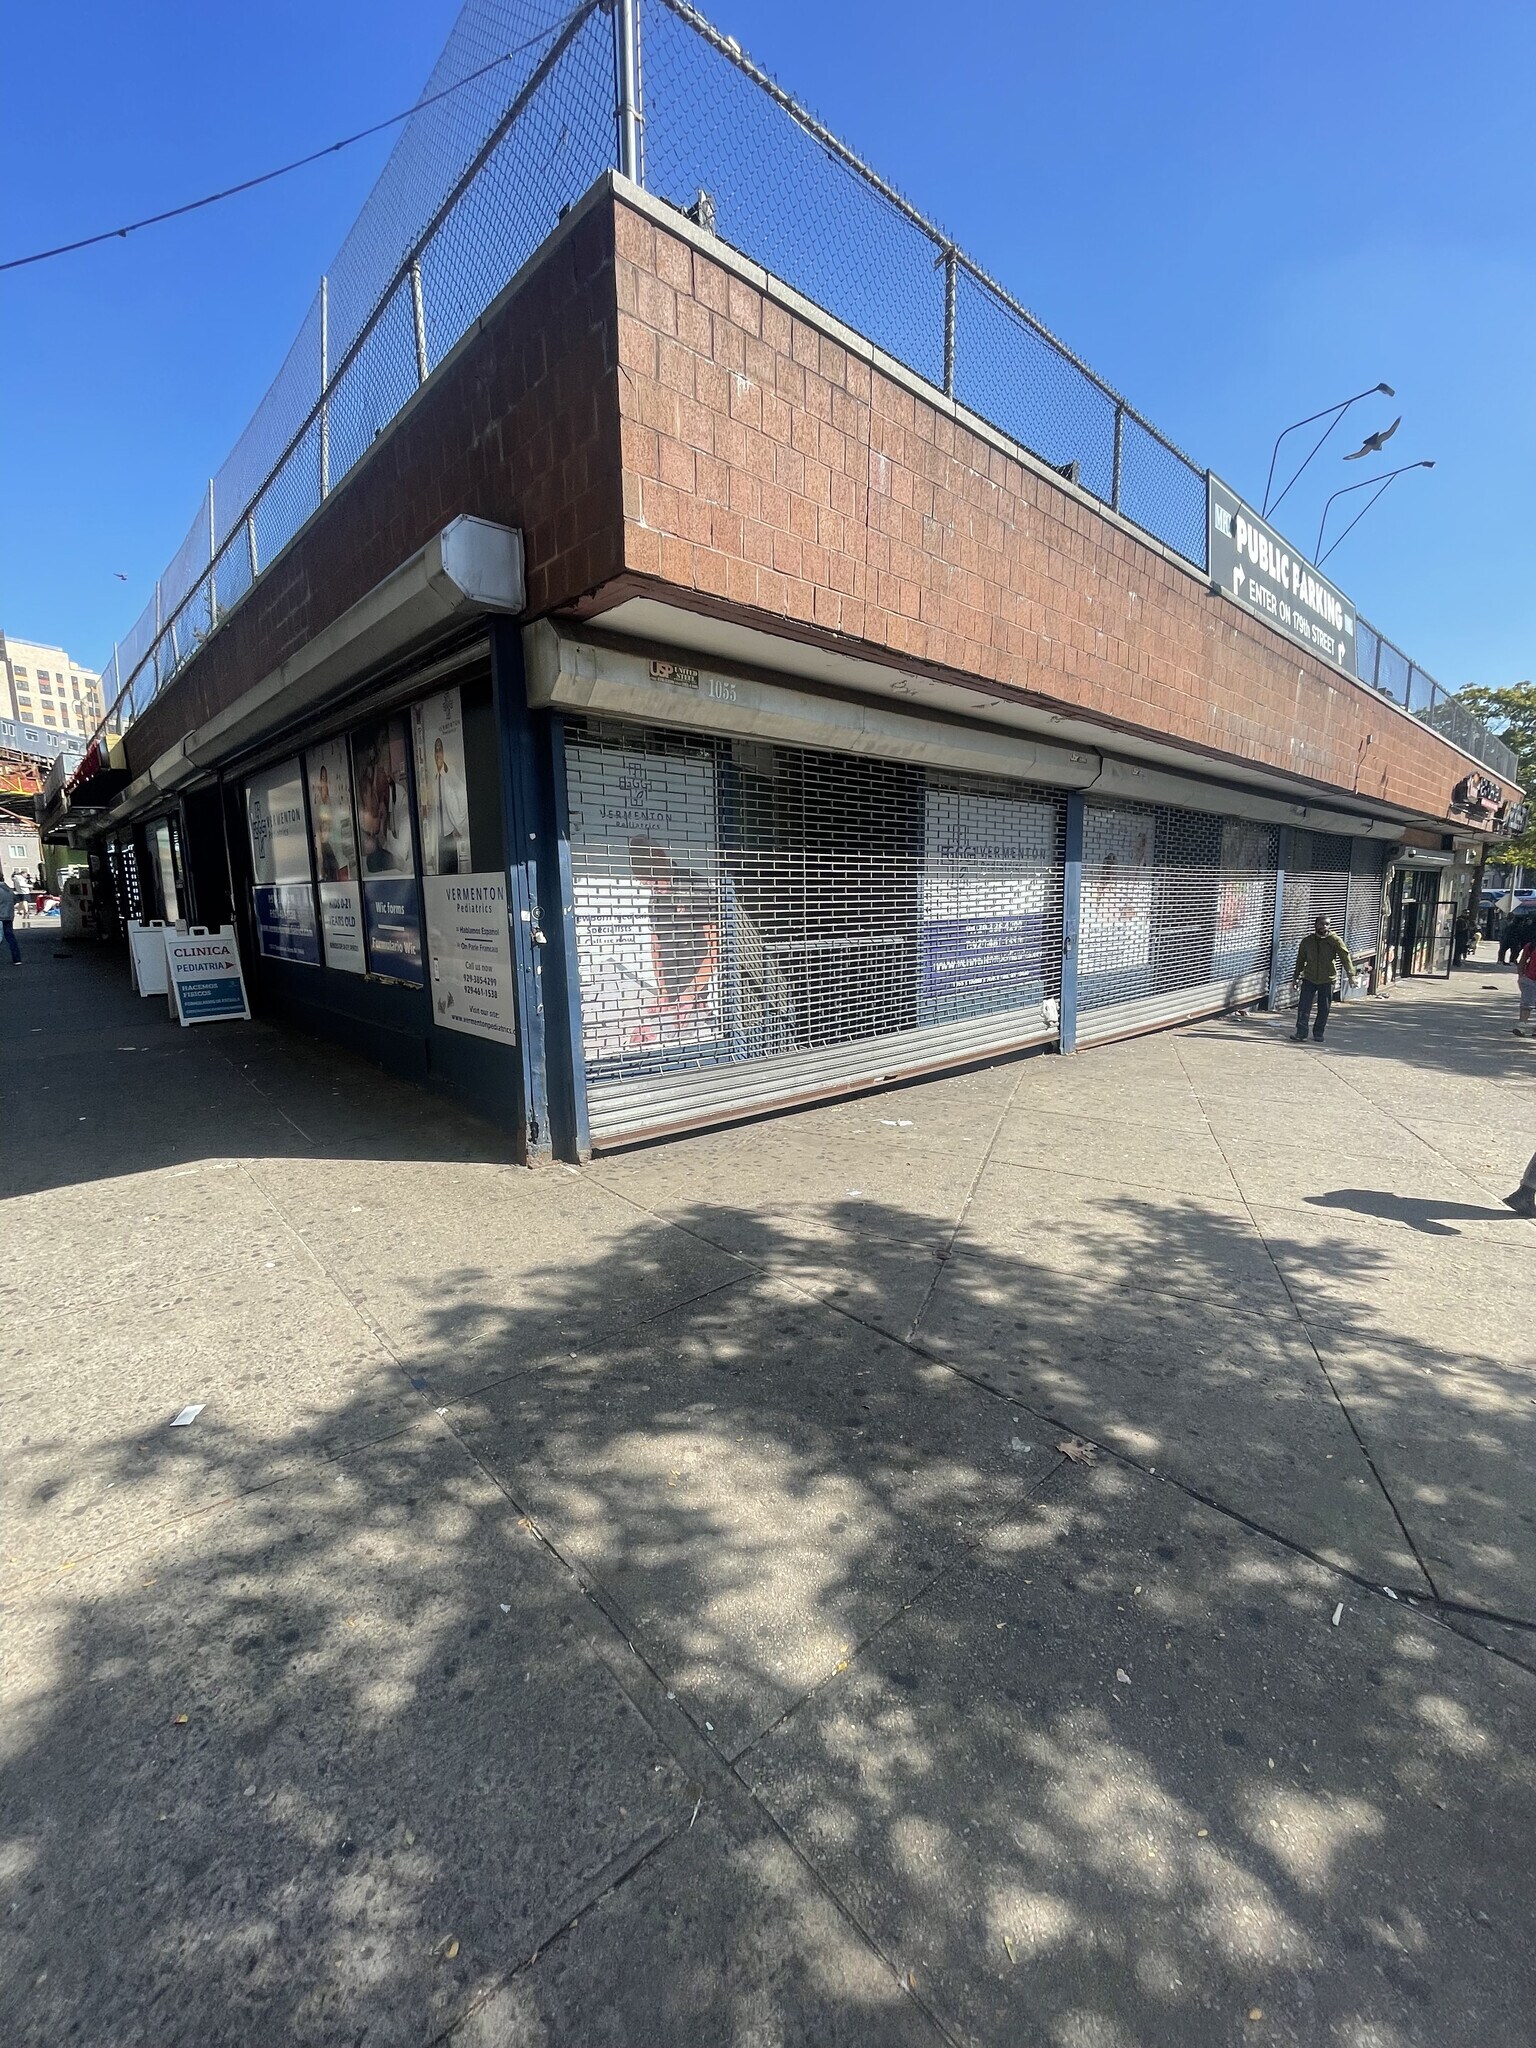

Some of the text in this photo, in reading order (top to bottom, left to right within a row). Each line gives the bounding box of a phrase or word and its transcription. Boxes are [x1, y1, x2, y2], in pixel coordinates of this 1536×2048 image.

[1236, 514, 1343, 631] PUBLIC PARKING
[1249, 578, 1335, 655] ENTER ON 179th STREET
[650, 660, 674, 679] USP
[674, 666, 698, 677] UNITED
[708, 679, 737, 702] 1055
[600, 810, 672, 821] VERMENTON
[980, 845, 1046, 860] VERMENTON
[446, 886, 504, 901] VERMENTON
[375, 901, 405, 915] Wic forms
[456, 902, 493, 914] Pediatrics
[344, 916, 356, 928] OLD
[174, 946, 231, 958] CLINICA
[404, 941, 416, 955] Wic
[177, 961, 225, 973] PEDIATRIA
[465, 961, 474, 970] Call
[182, 983, 218, 991] HACEMOS
